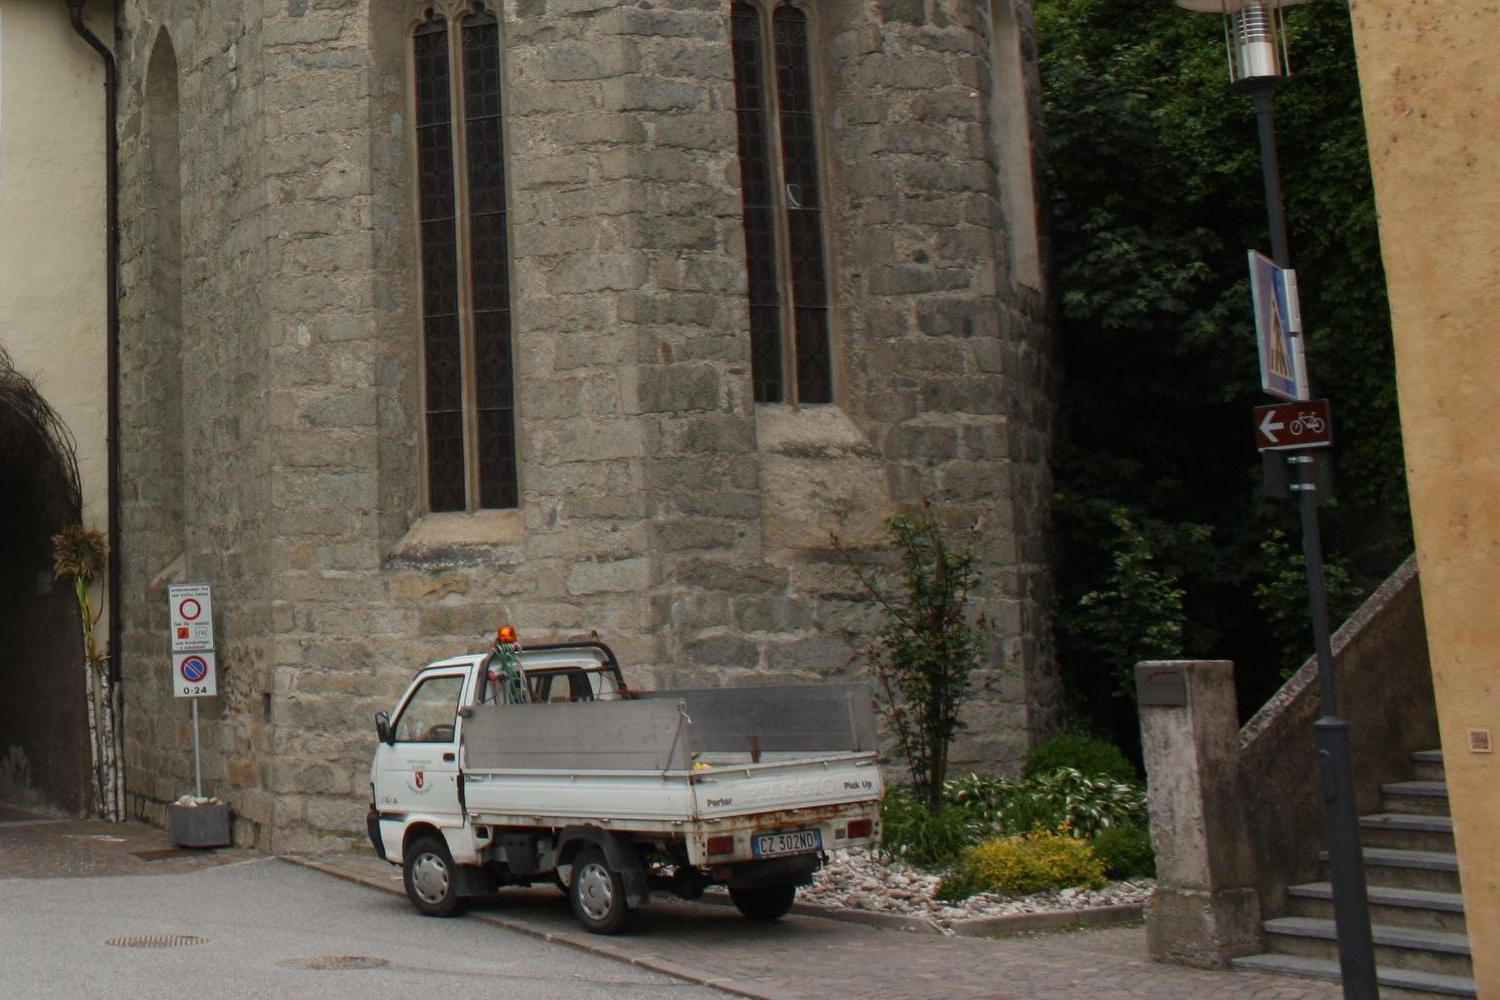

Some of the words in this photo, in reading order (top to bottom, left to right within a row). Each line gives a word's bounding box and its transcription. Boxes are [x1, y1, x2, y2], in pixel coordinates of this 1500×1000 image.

[183, 686, 208, 695] 0-24
[844, 781, 860, 791] Pick
[861, 779, 872, 789] Up
[706, 797, 733, 808] Porter
[760, 836, 775, 853] CZ
